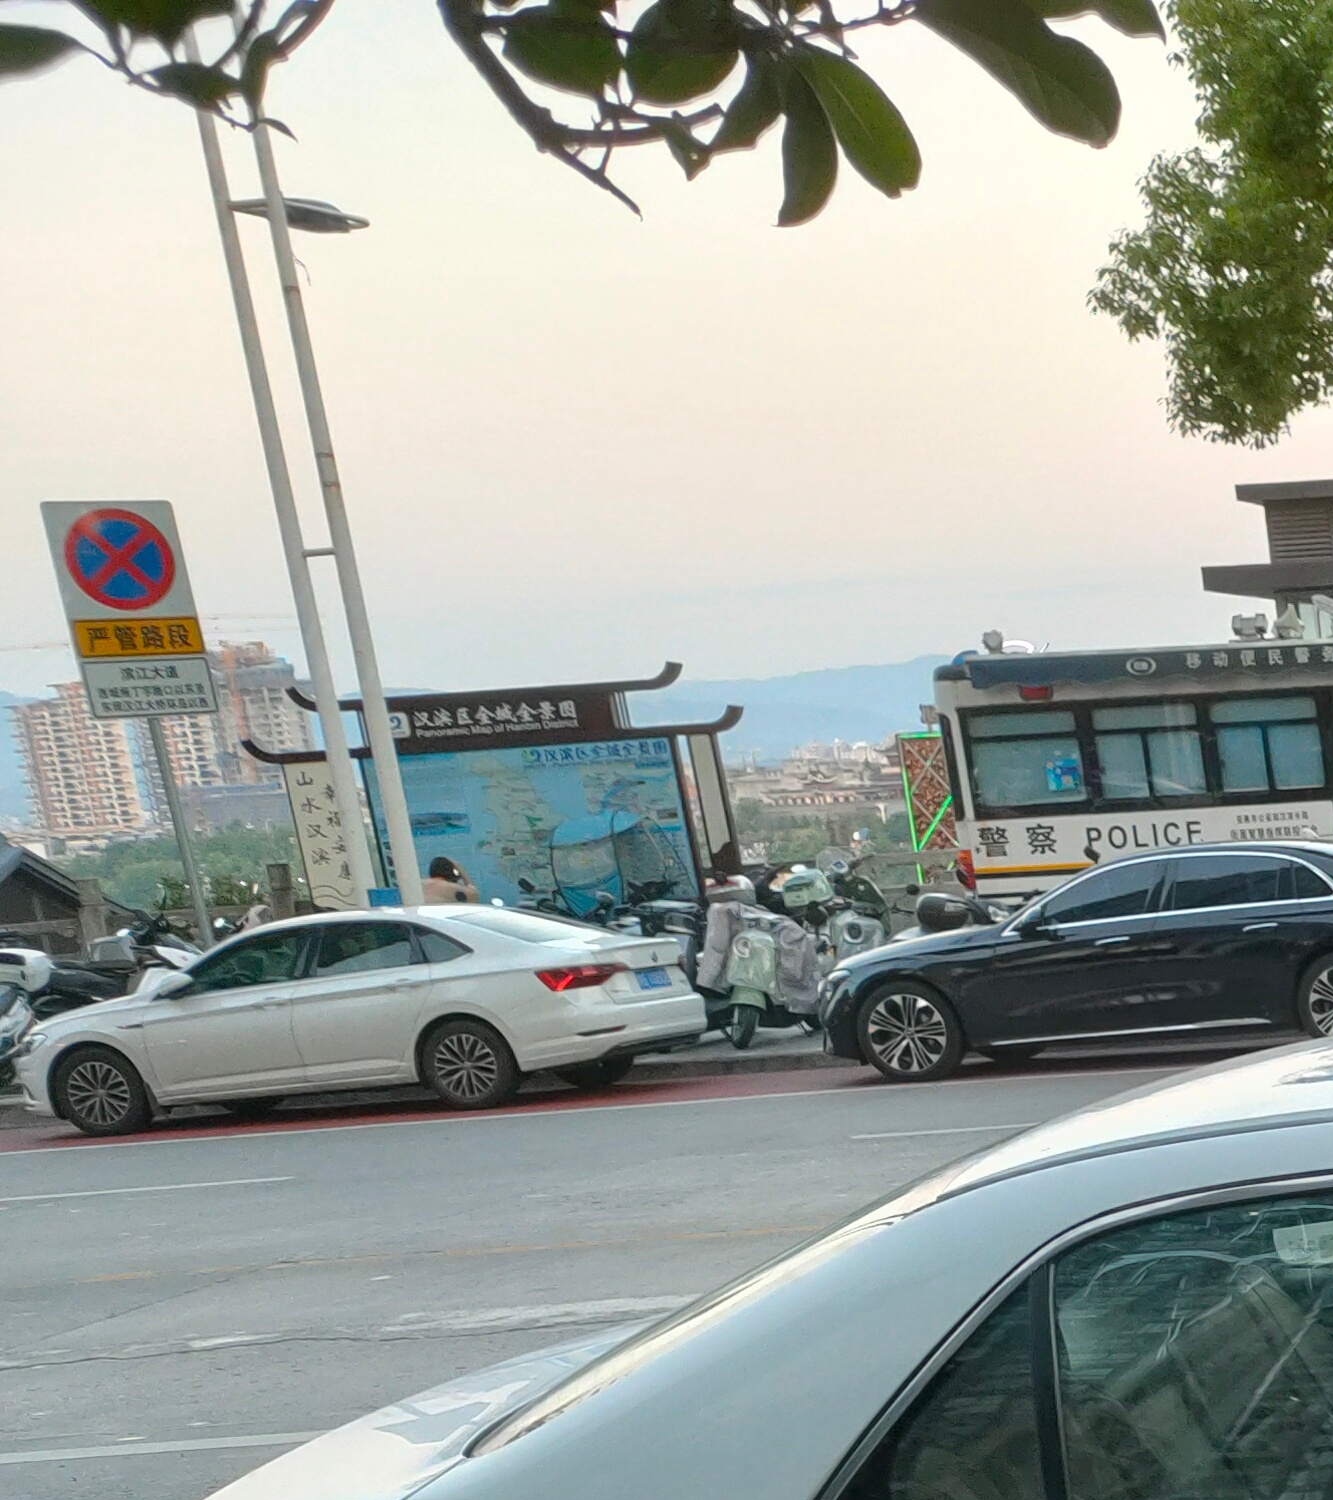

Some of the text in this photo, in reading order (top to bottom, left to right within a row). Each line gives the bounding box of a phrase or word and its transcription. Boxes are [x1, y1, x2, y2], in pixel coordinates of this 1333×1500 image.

[86, 624, 192, 652] 严管路段
[120, 665, 180, 681] 滨江大道
[976, 823, 1057, 857] 警察
[1086, 821, 1202, 849] POLICE
